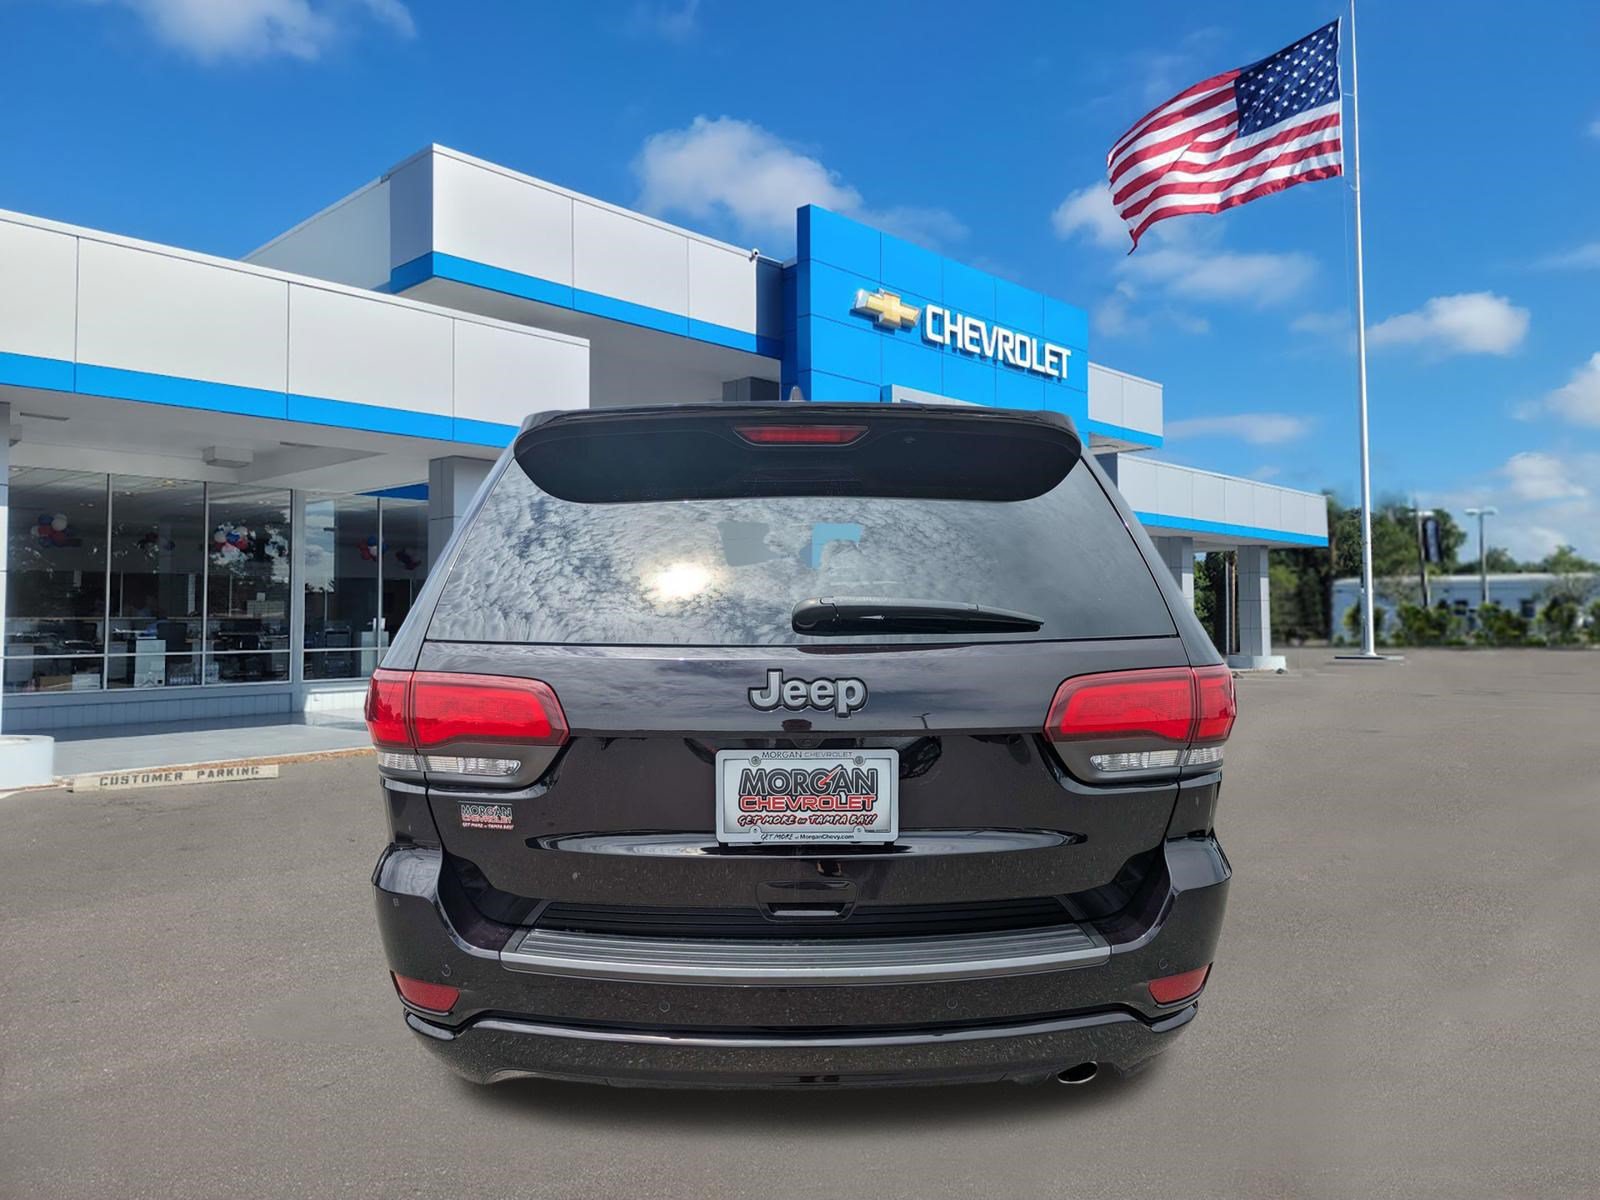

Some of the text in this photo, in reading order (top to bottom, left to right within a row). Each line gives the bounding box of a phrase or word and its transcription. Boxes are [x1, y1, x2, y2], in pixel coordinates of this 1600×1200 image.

[925, 303, 1072, 379] CHEVROLET
[748, 668, 868, 718] Jeep
[99, 766, 260, 787] CUSTOMER PARKING
[739, 764, 878, 796] MORGAN
[461, 804, 512, 817] MORGAN
[739, 795, 877, 812] CHEVROLET
[737, 814, 761, 827] GET
[761, 814, 797, 825] MORE
[808, 814, 848, 826] TAMPA
[848, 813, 878, 826] BAY!
